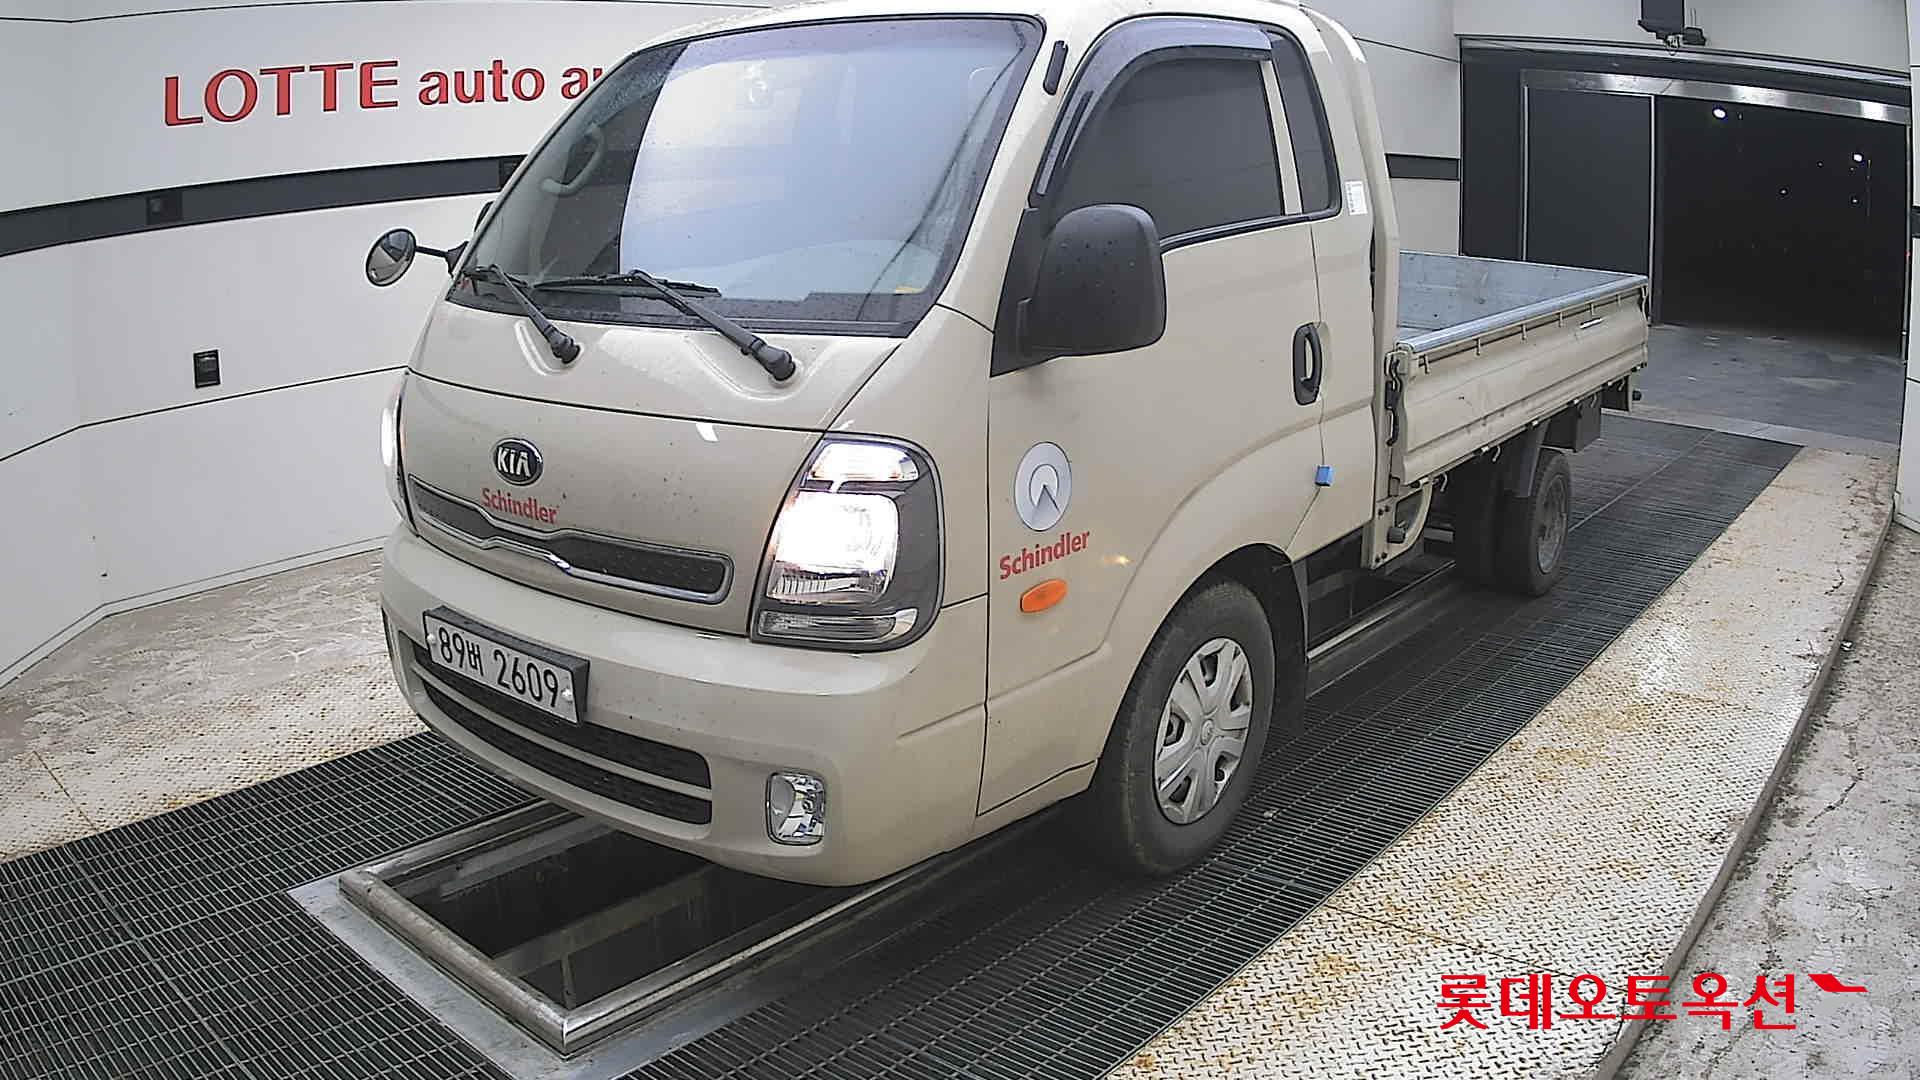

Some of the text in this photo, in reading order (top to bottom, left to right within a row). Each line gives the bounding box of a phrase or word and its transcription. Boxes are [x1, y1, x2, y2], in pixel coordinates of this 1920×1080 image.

[164, 60, 398, 127] LOTTE
[418, 59, 545, 105] auto
[497, 446, 531, 478] KIA
[482, 487, 560, 524] Schindler
[1000, 531, 1090, 580] Schindler
[438, 626, 559, 708] 89버 2609
